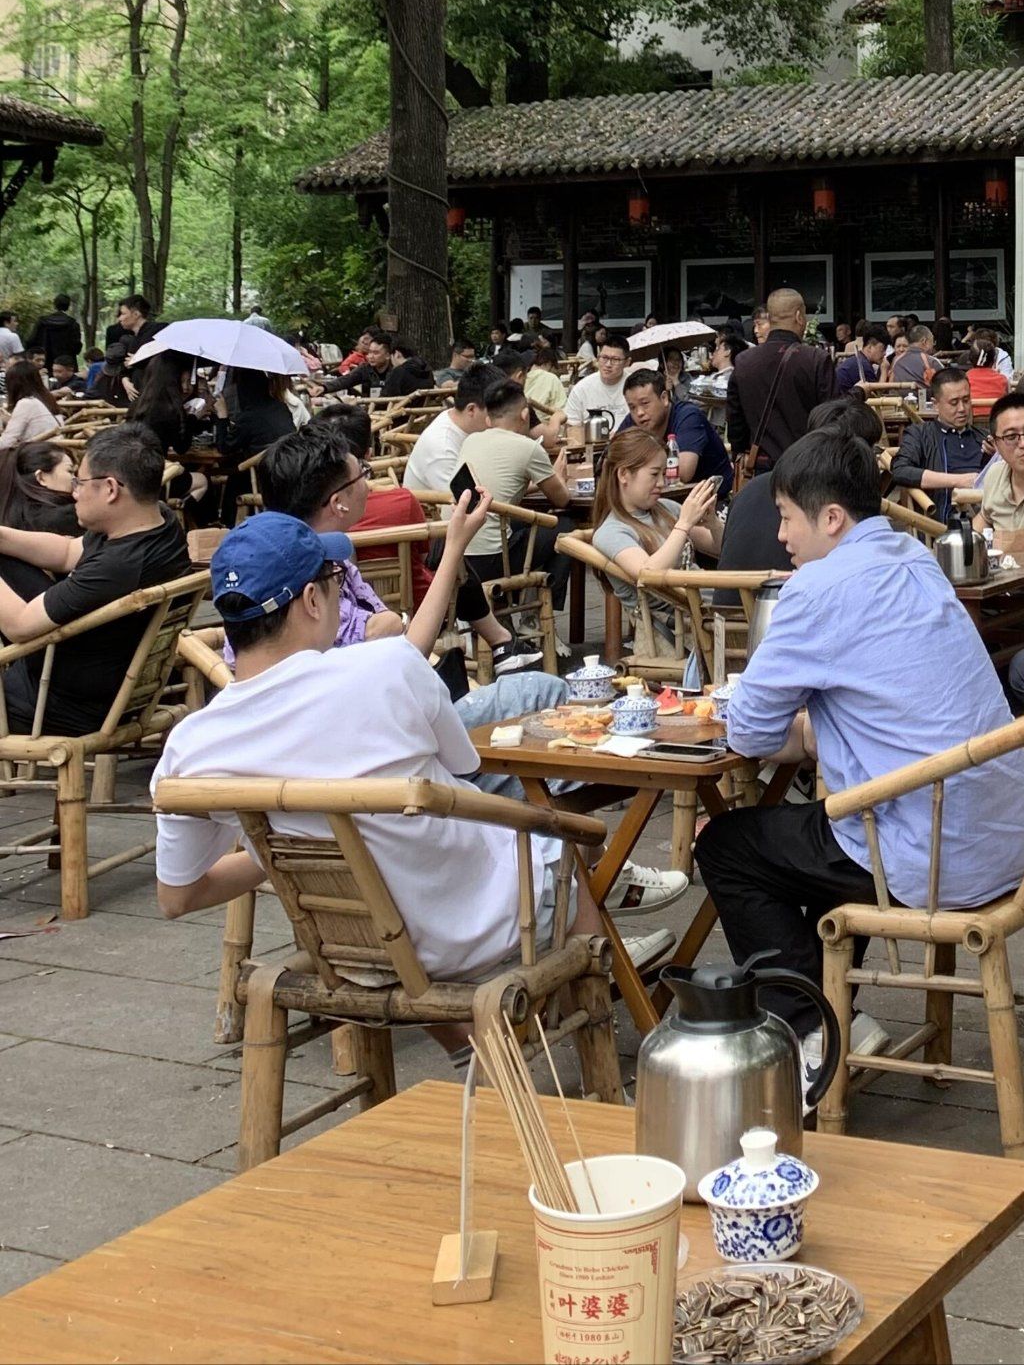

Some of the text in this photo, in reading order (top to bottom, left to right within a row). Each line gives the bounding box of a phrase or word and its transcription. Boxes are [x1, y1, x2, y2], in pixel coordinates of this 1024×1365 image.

[559, 1292, 631, 1320] 叶婆婆
[580, 1332, 602, 1342] 1980
